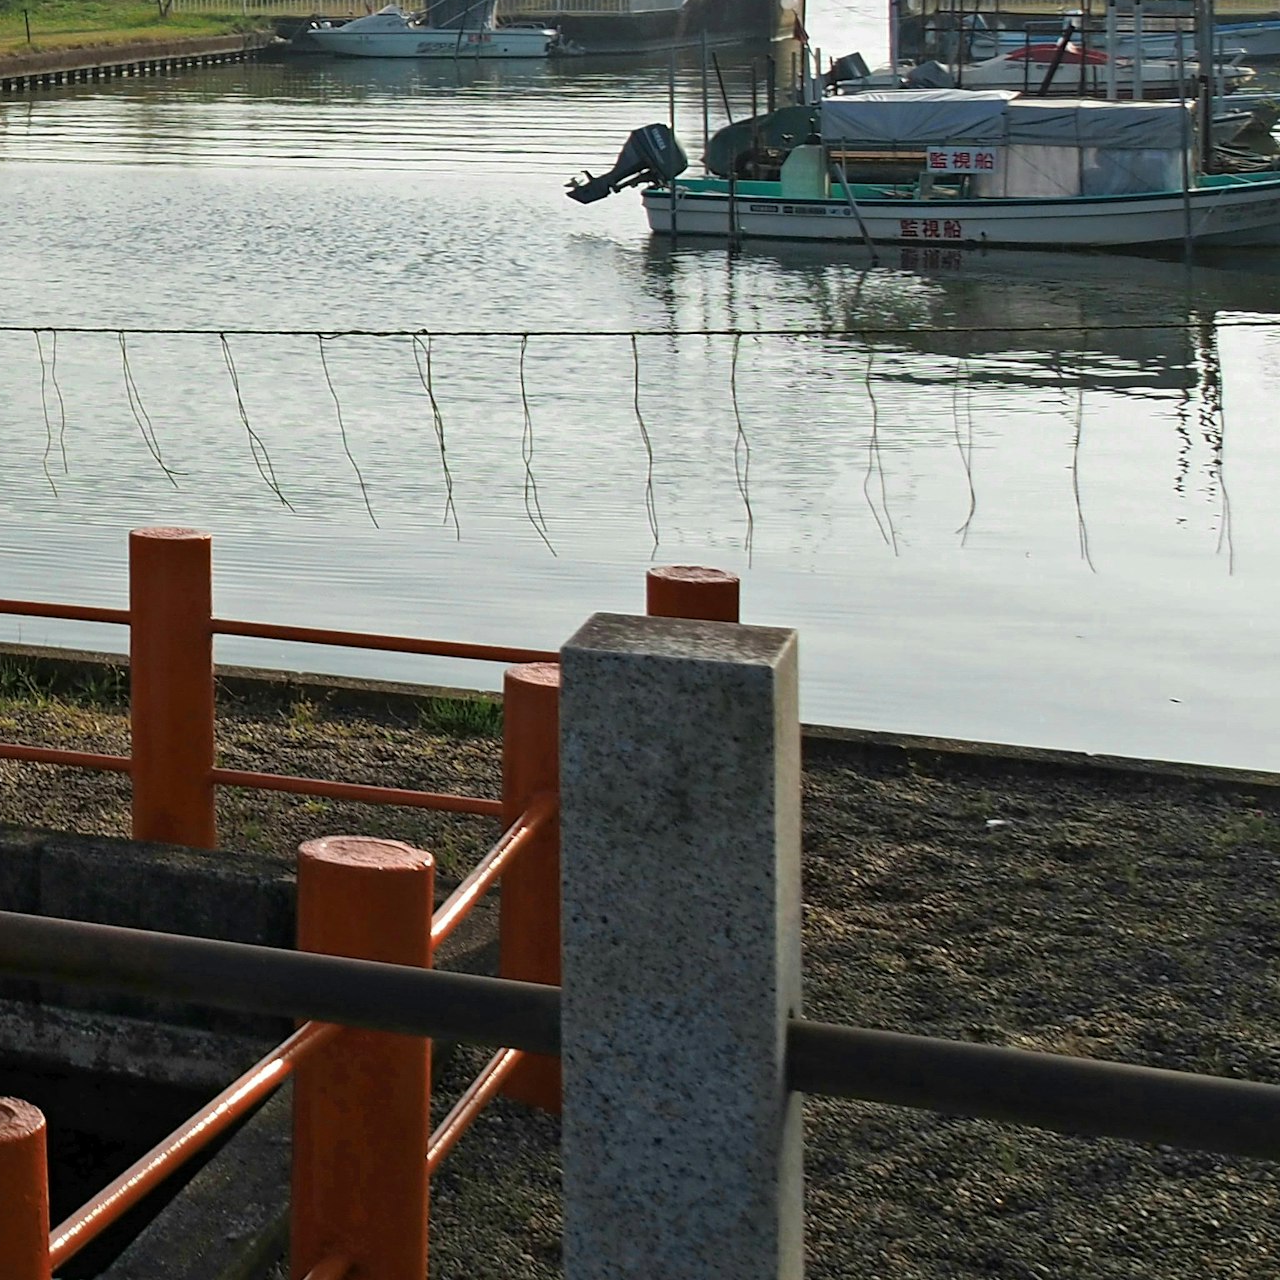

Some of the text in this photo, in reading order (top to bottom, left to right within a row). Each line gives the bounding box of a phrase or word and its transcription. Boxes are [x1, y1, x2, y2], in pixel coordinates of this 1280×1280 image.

[929, 151, 994, 170] 監視船
[900, 219, 962, 238] 監視船
